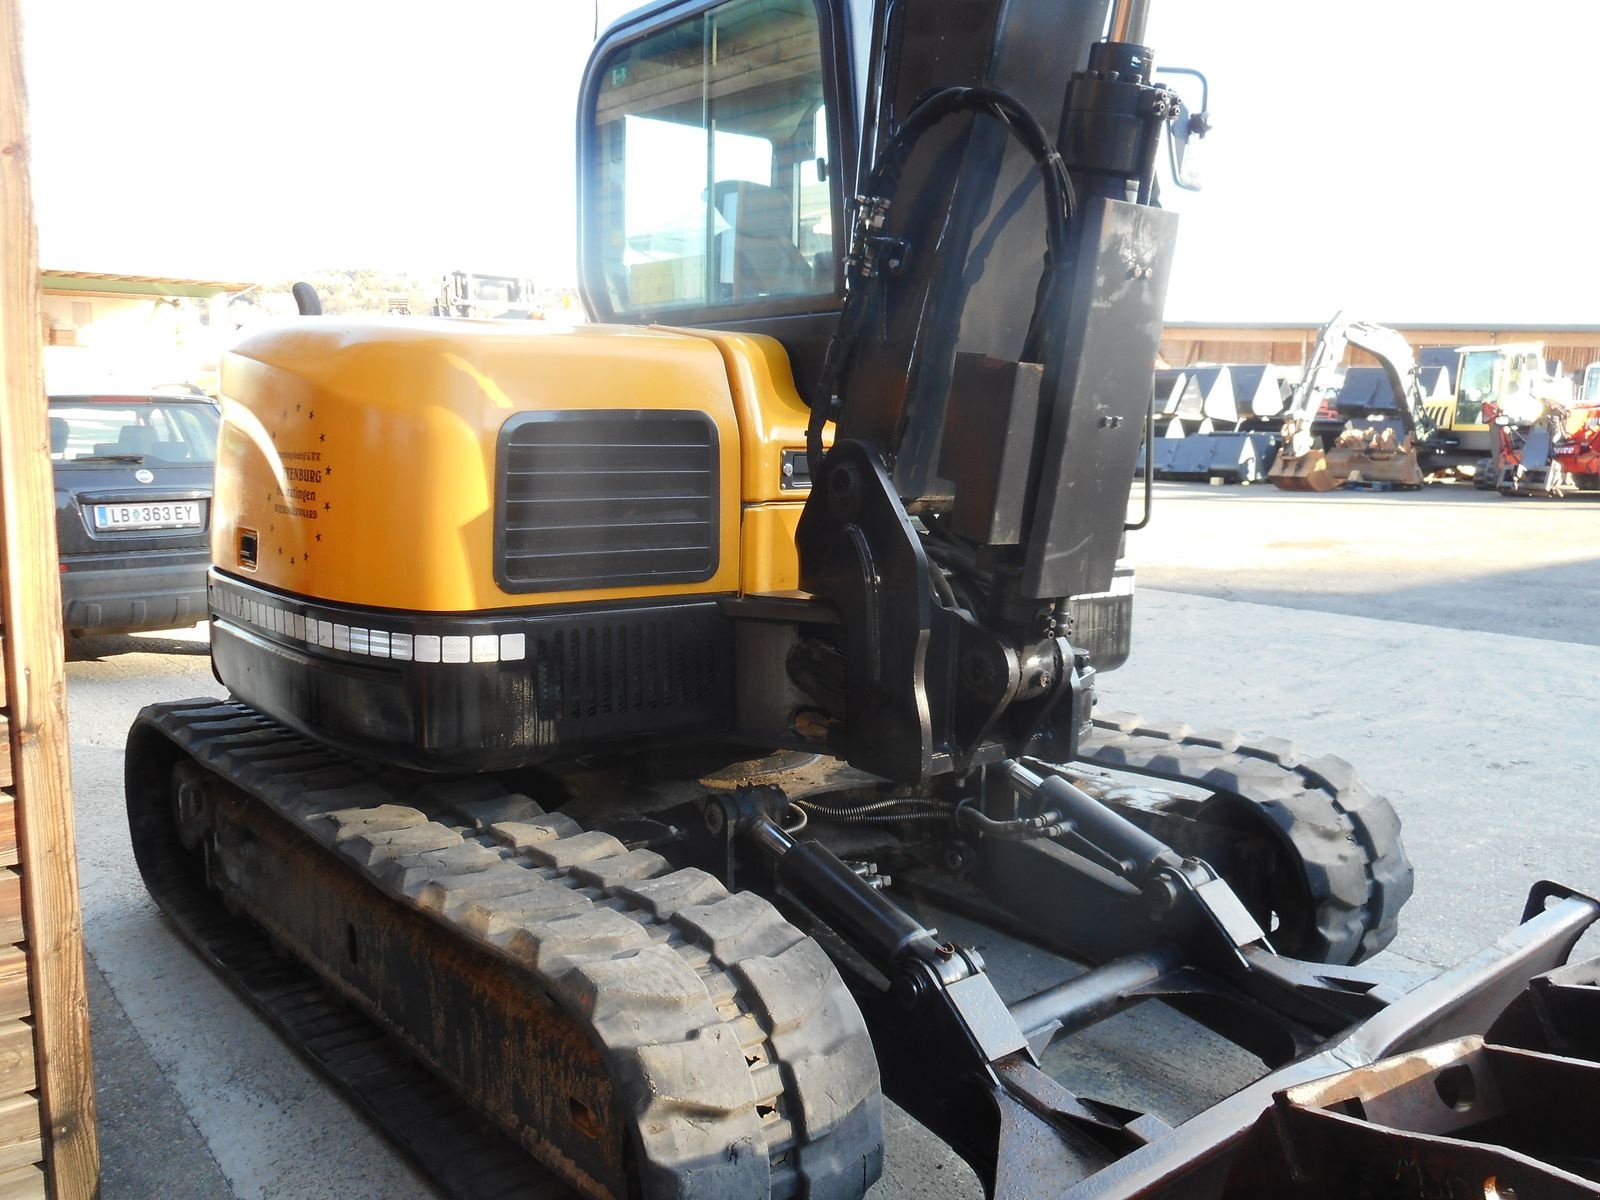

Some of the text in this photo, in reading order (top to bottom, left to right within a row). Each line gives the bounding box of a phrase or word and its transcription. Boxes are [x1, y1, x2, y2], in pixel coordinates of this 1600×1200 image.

[111, 506, 192, 523] LB 363 EY
